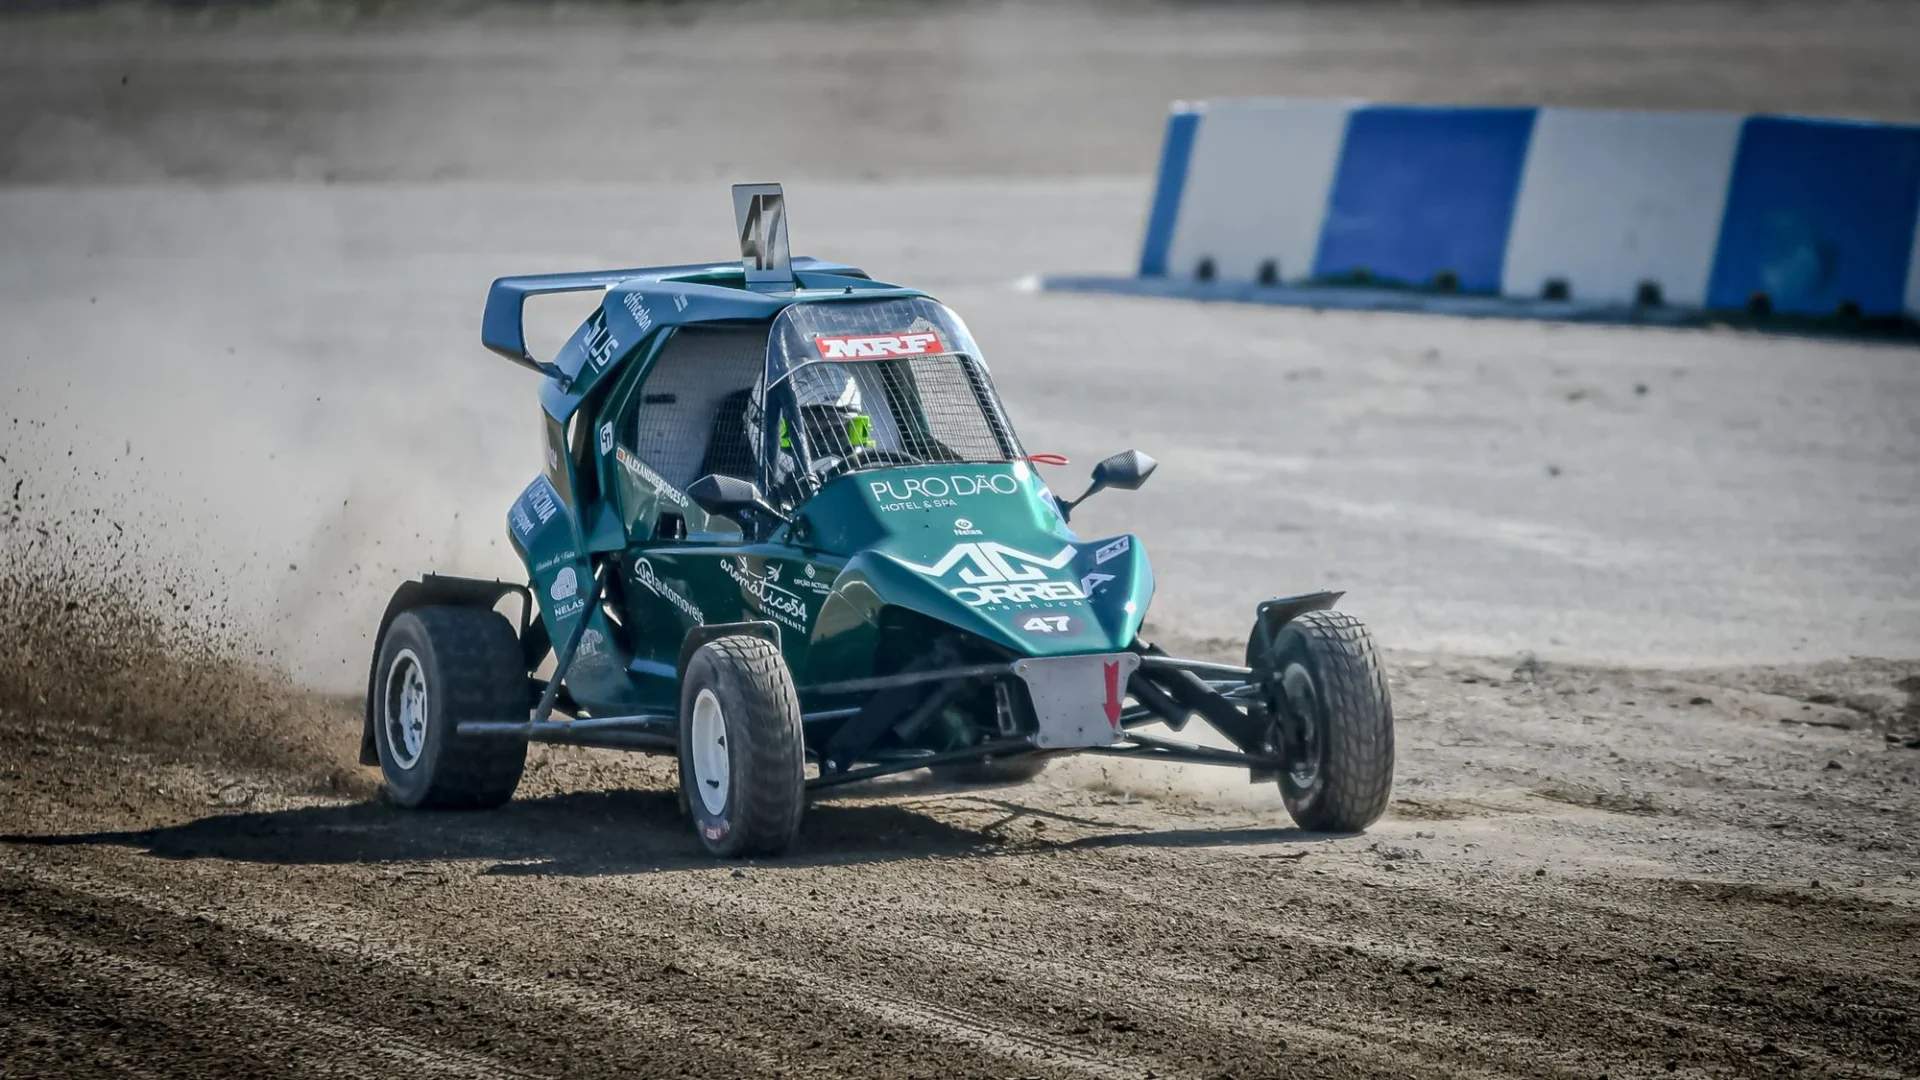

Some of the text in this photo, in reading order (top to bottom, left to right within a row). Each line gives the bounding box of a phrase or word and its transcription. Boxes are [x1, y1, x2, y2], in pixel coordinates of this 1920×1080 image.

[741, 194, 782, 271] 47
[822, 334, 937, 357] MRF
[870, 474, 1017, 501] PURO DÃO
[880, 499, 957, 512] HOTEL & SPA
[950, 572, 1116, 606] ORREIA
[554, 599, 585, 617] NELAS
[759, 604, 806, 634] RESTAURANTE
[1023, 615, 1071, 632] 47
